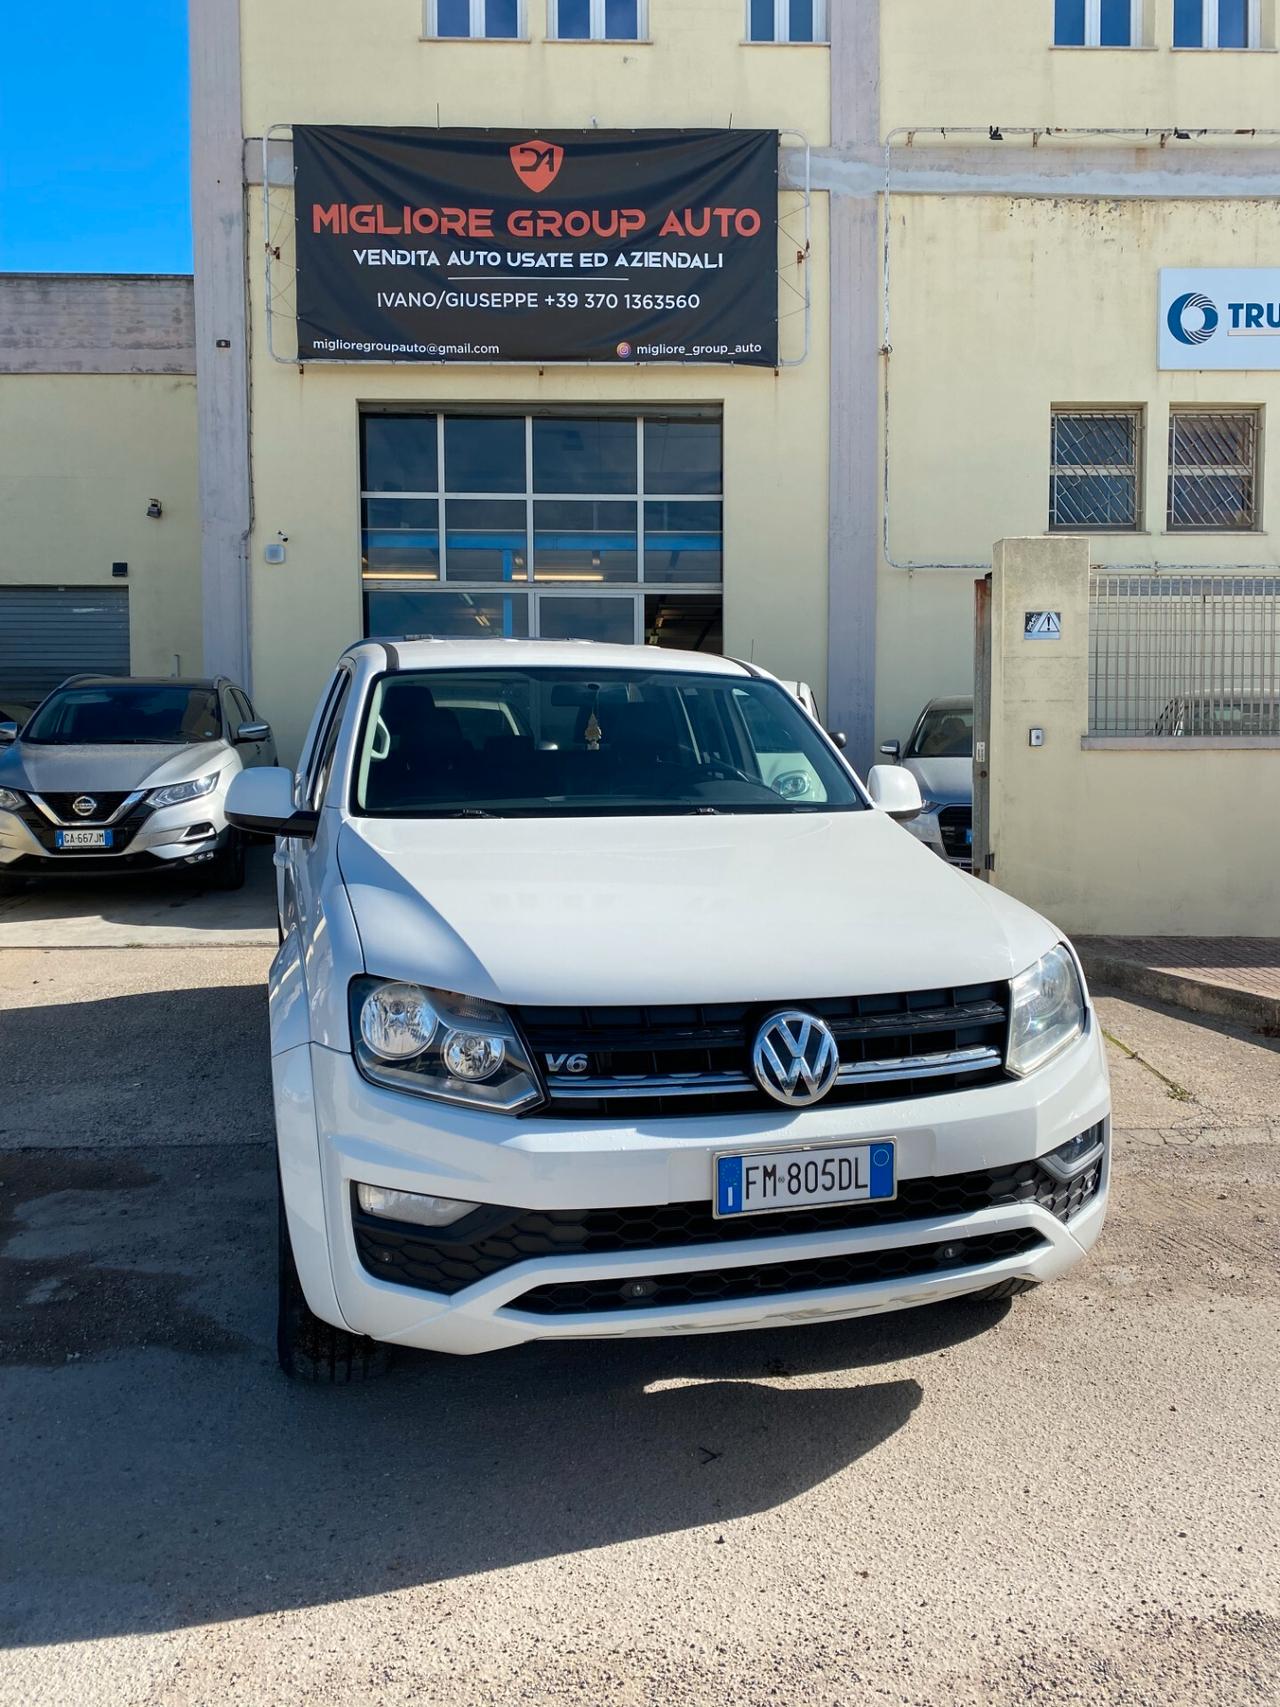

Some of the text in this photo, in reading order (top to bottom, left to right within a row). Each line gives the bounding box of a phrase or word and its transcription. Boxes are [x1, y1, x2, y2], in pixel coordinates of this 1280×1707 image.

[312, 203, 762, 239] MIGLIORE GROUP AUTO
[353, 249, 724, 269] VENDITA AUTO USATE ED AZIENDALI
[376, 290, 701, 310] IVANO/GIUSEPPE +39 370 1363560
[312, 339, 500, 355] miglioregroupauto@gmail.com
[636, 342, 762, 356] migliore_group_auto
[544, 1053, 588, 1073] V6
